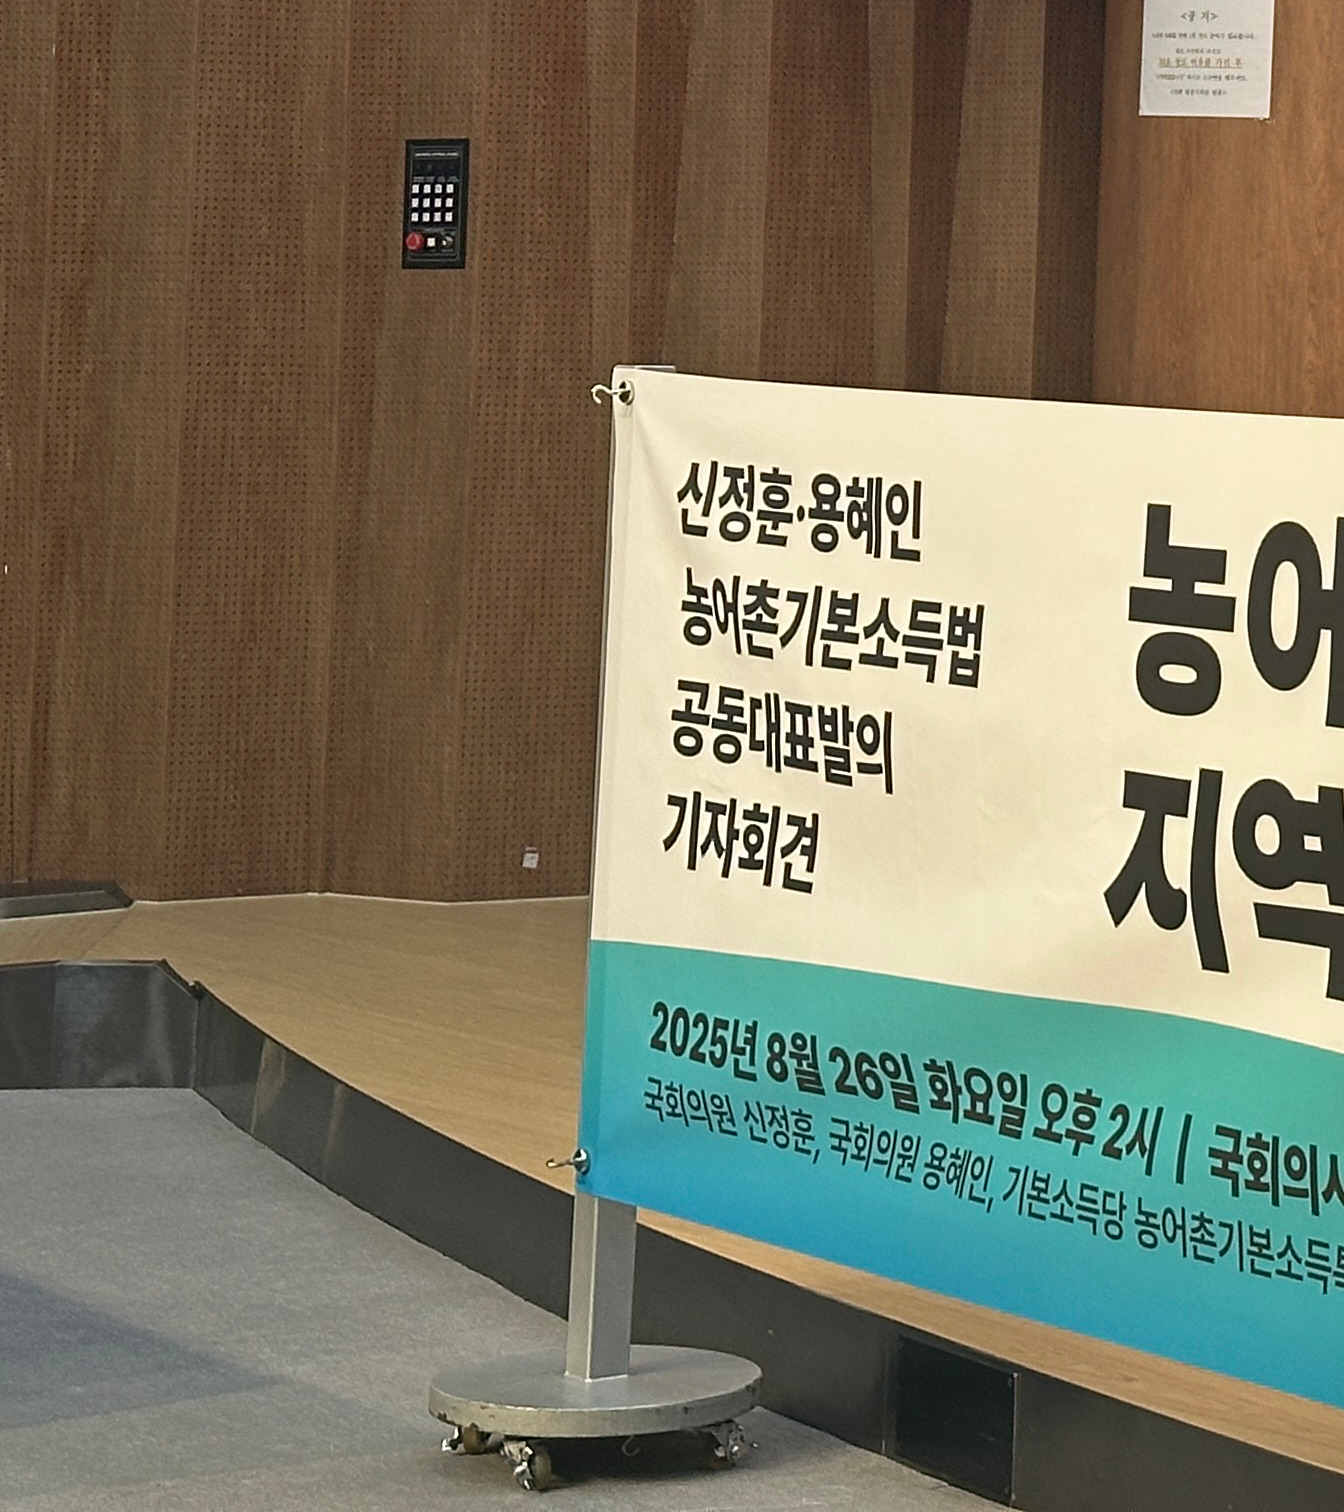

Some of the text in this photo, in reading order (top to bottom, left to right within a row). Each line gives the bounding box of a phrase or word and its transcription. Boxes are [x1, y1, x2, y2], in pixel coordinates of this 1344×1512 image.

[676, 460, 923, 562] 신정훈·용혜인
[681, 566, 985, 689] 농어촌기본소득법
[670, 678, 895, 795] 공동대표발의
[662, 790, 819, 894] 기자회견
[649, 1001, 759, 1083] 2025년
[764, 1031, 826, 1097] 8월
[828, 1046, 920, 1116] 26일
[922, 1057, 1030, 1139] 화요일
[1032, 1082, 1102, 1158] 오후
[1101, 1102, 1164, 1177] 2시
[643, 1076, 739, 1139] 국회의원
[742, 1099, 822, 1164] 신정훈,
[828, 1116, 922, 1184] 국회의원
[923, 1141, 996, 1215] 용혜인,
[1002, 1164, 1128, 1242] 기본소득당
